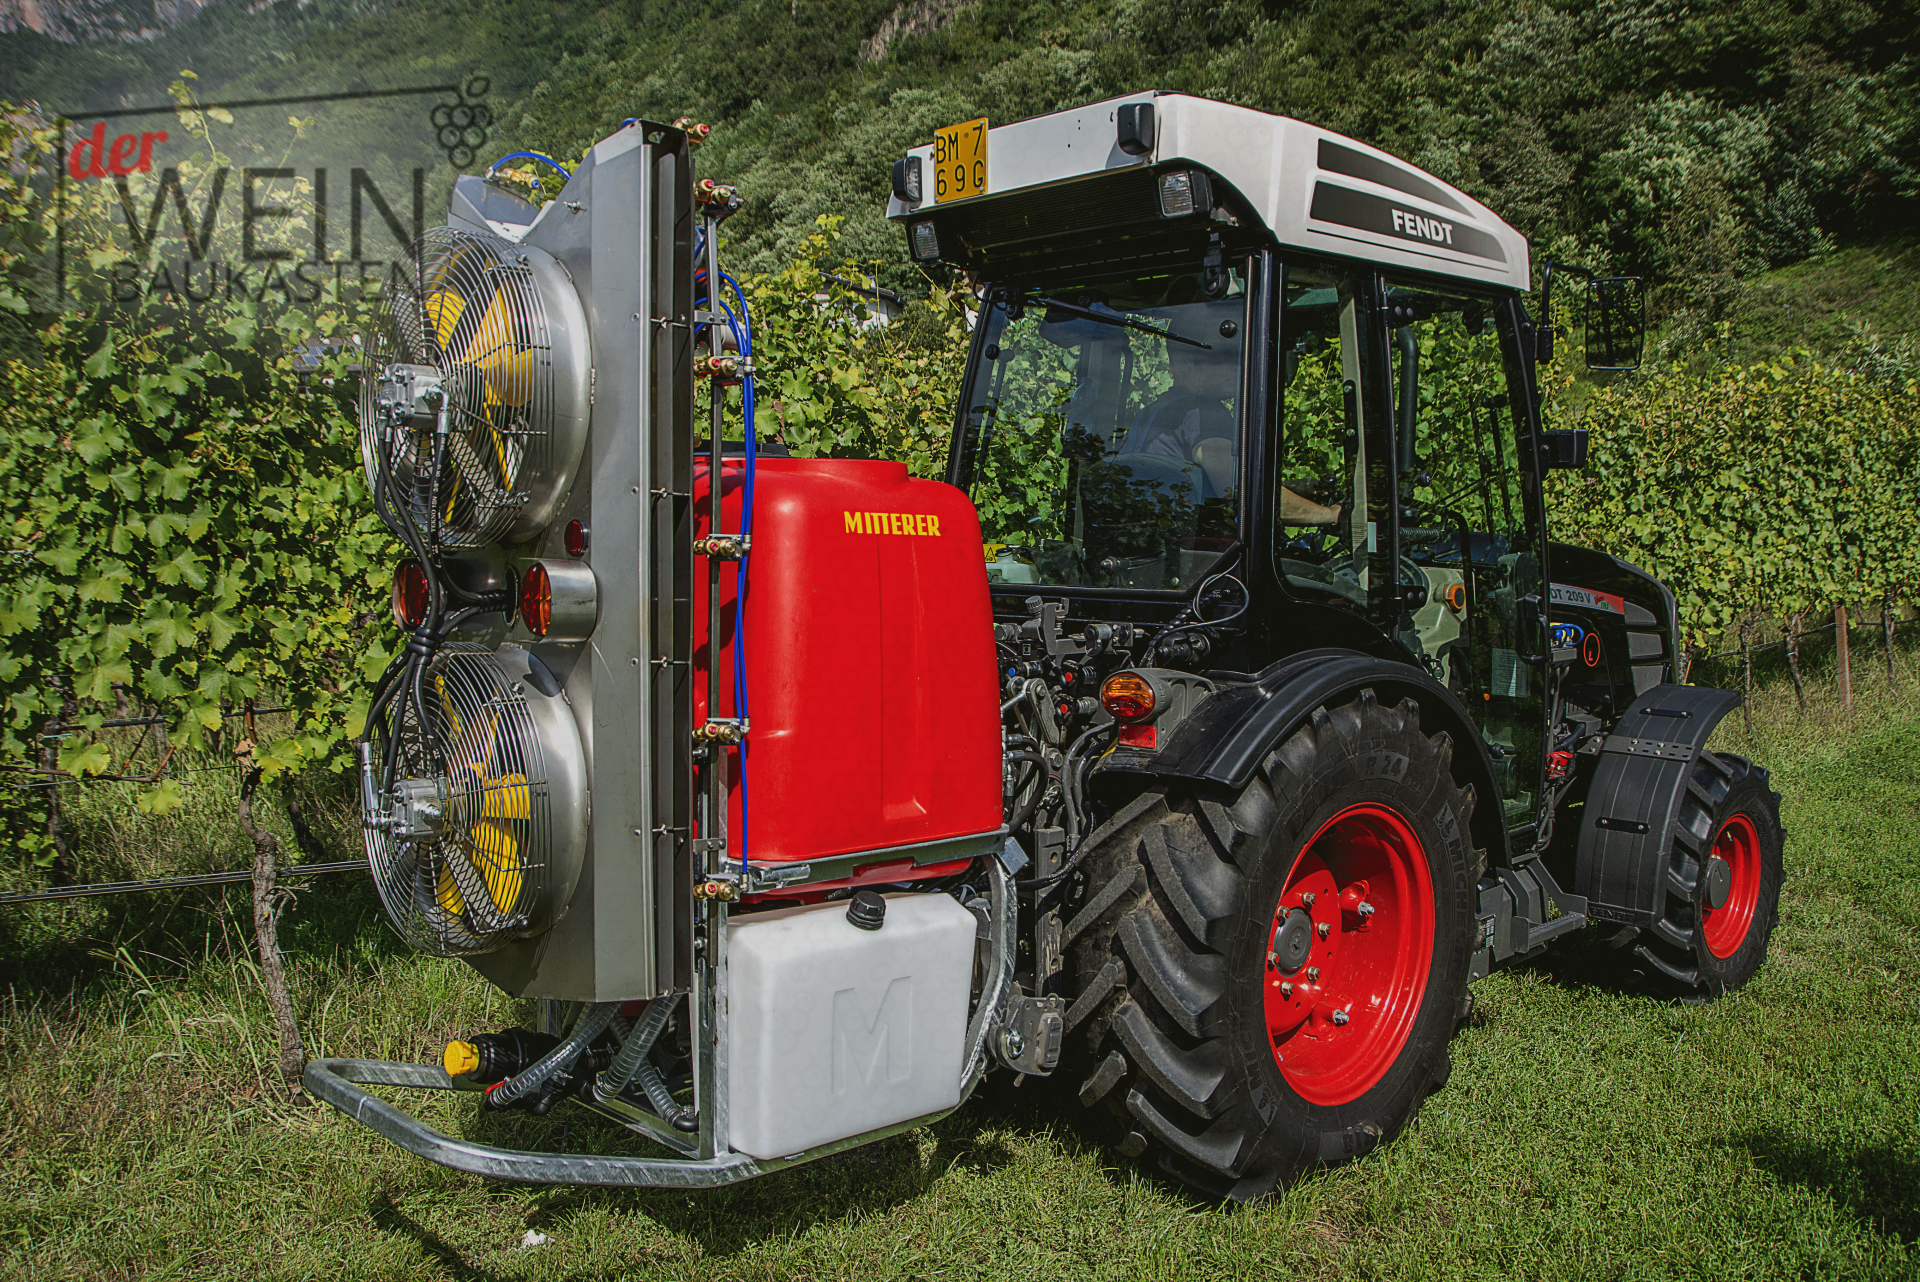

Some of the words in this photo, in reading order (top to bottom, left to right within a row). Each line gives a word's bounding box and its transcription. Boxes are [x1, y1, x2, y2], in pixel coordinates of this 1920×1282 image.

[936, 131, 959, 164] BM
[972, 122, 985, 156] 7
[1391, 208, 1453, 245] FENDT
[843, 511, 942, 537] MITTERER
